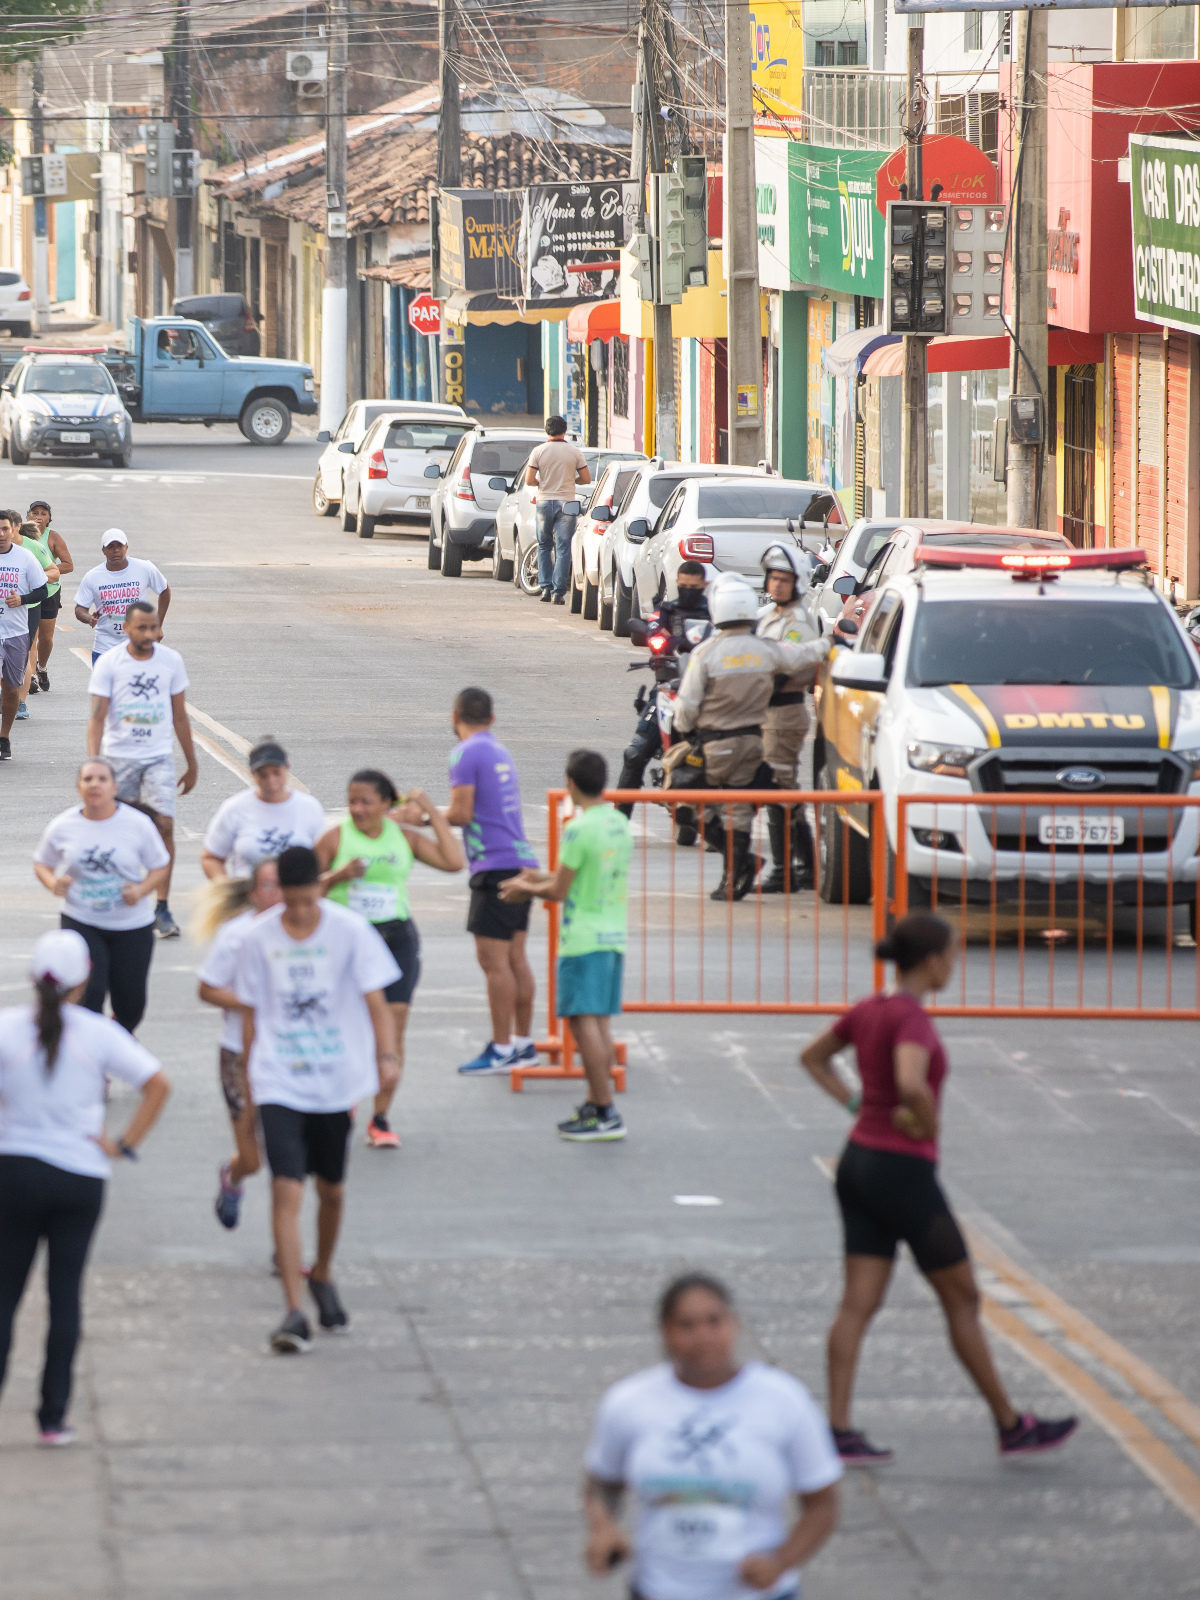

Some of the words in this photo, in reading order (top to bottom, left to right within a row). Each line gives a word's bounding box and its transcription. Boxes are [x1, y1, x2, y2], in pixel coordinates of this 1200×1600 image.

[1141, 158, 1169, 220] CASA
[1174, 163, 1200, 228] DAS
[533, 192, 576, 234] Mania
[581, 195, 596, 220] de
[600, 187, 640, 222] Belez
[468, 234, 516, 259] MAV
[412, 305, 441, 322] PAR
[444, 351, 464, 403] OUR
[100, 587, 141, 601] APROVADOS
[113, 623, 122, 631] 21
[1003, 711, 1146, 730] DMTU
